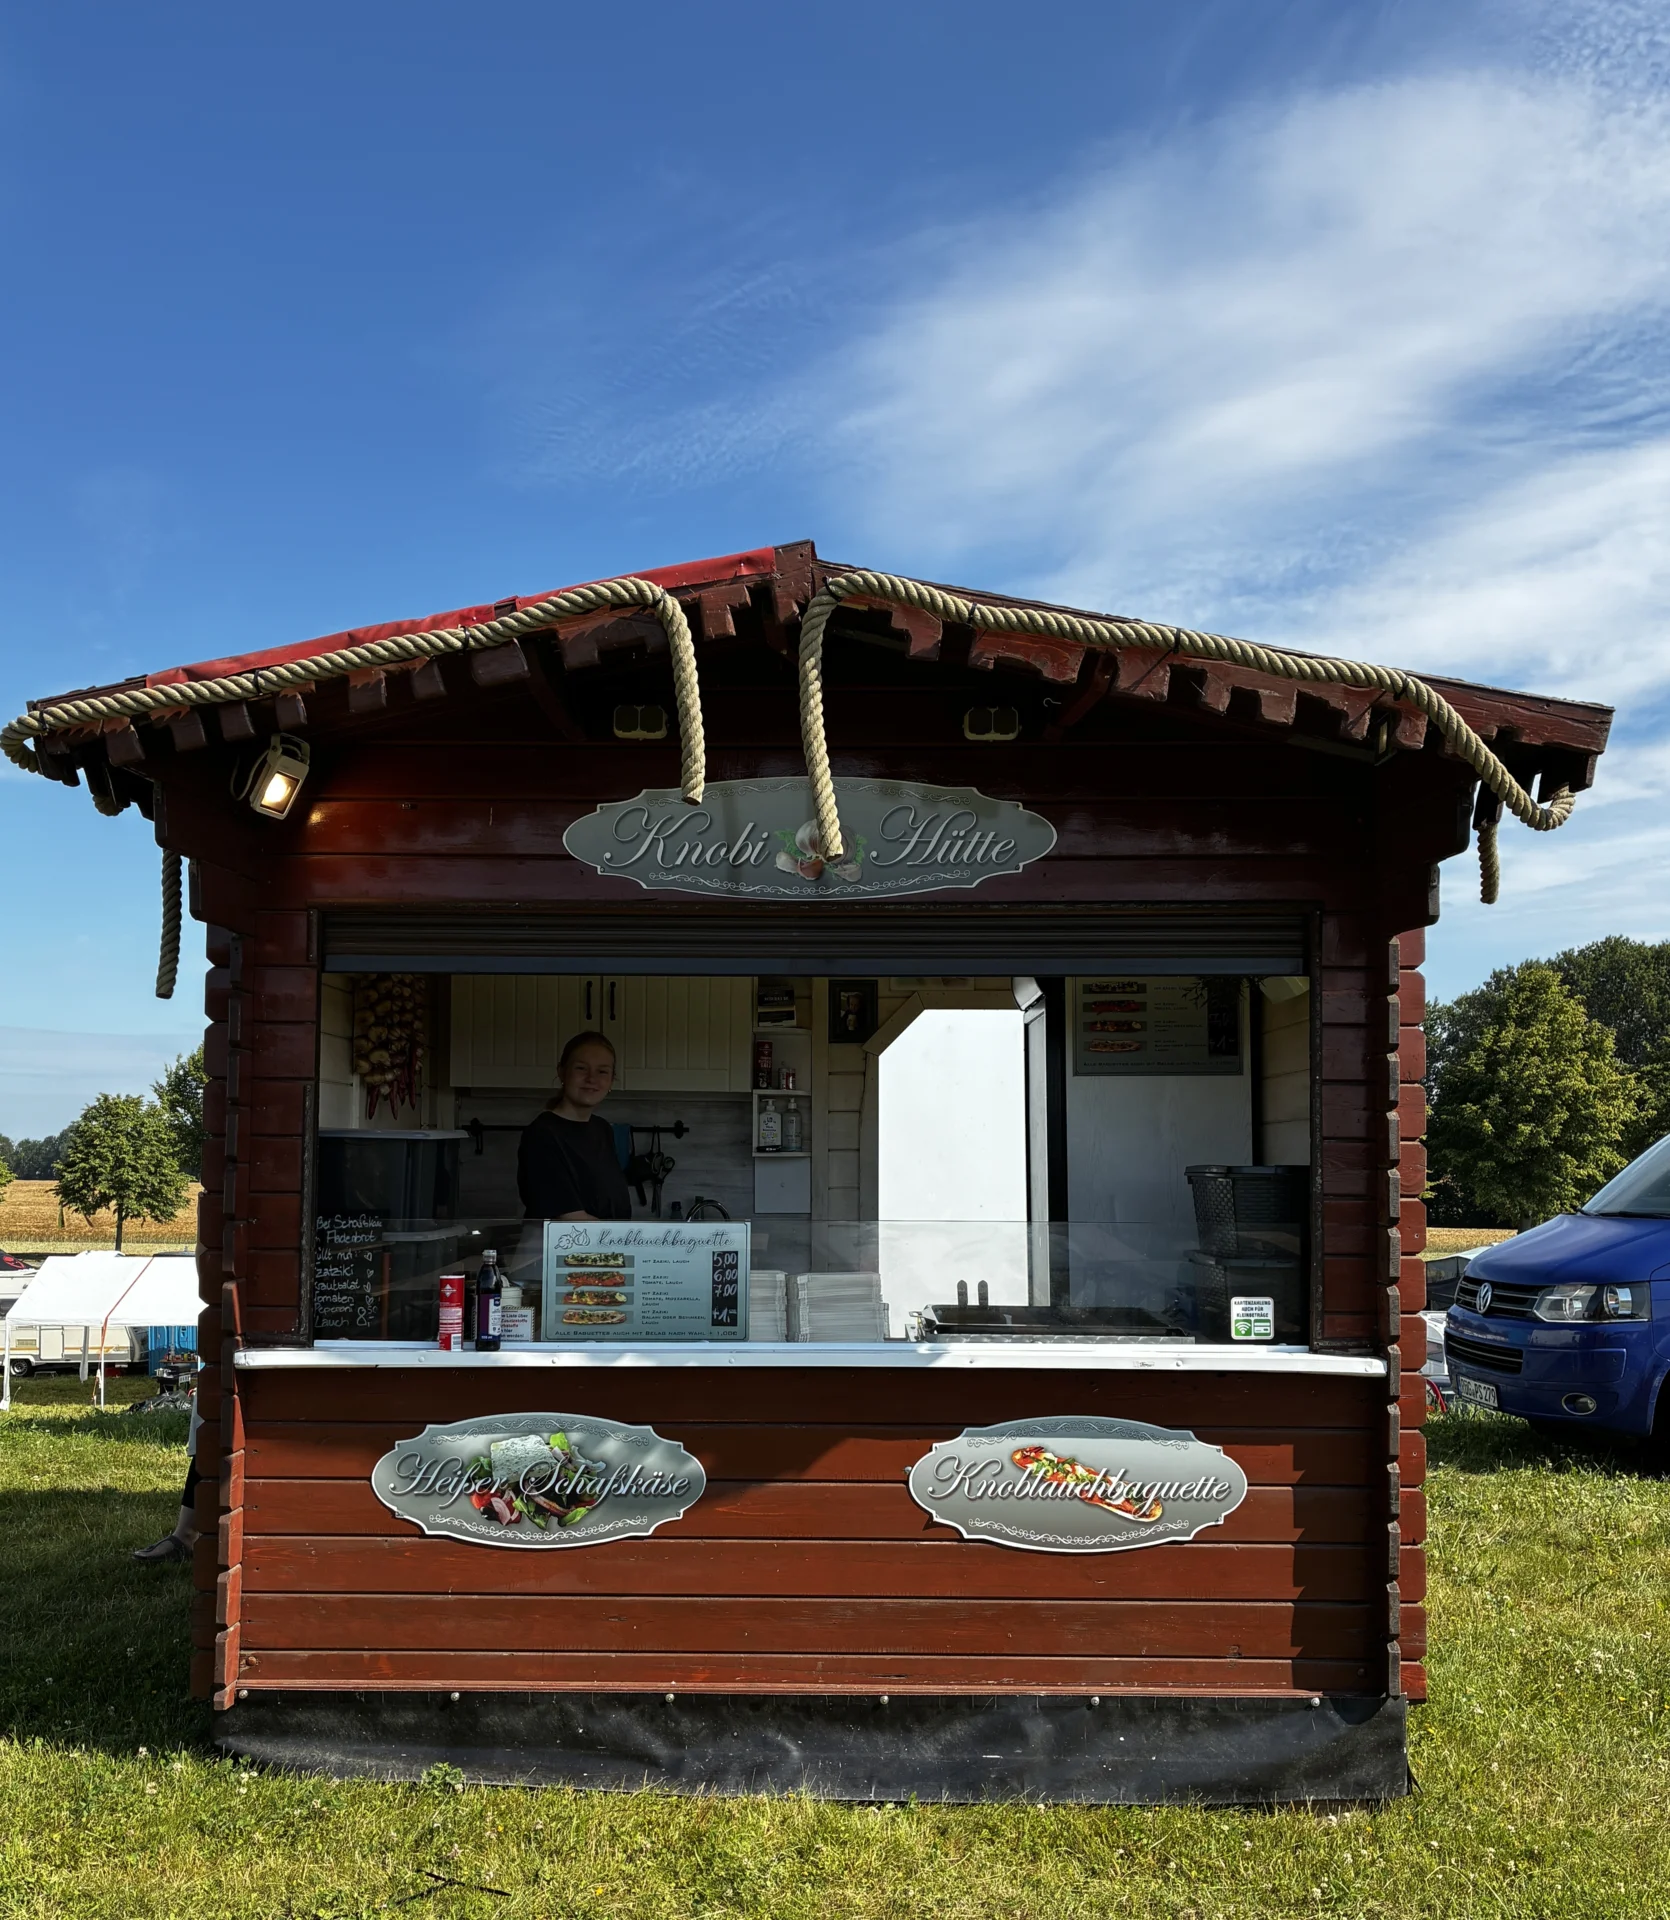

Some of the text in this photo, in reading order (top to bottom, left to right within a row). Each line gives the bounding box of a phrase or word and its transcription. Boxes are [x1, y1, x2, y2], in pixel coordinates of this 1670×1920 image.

[603, 804, 1018, 869] Knobi Hütte
[598, 1228, 735, 1254] Knoblauchbaguette
[713, 1252, 737, 1268] 5,00
[713, 1268, 738, 1282] 6,00
[713, 1283, 737, 1297] 7,00
[314, 1315, 350, 1328] Lauch
[389, 1452, 690, 1509] Heißer Schafskäse
[927, 1454, 1232, 1518] Knoblauchbaguette
